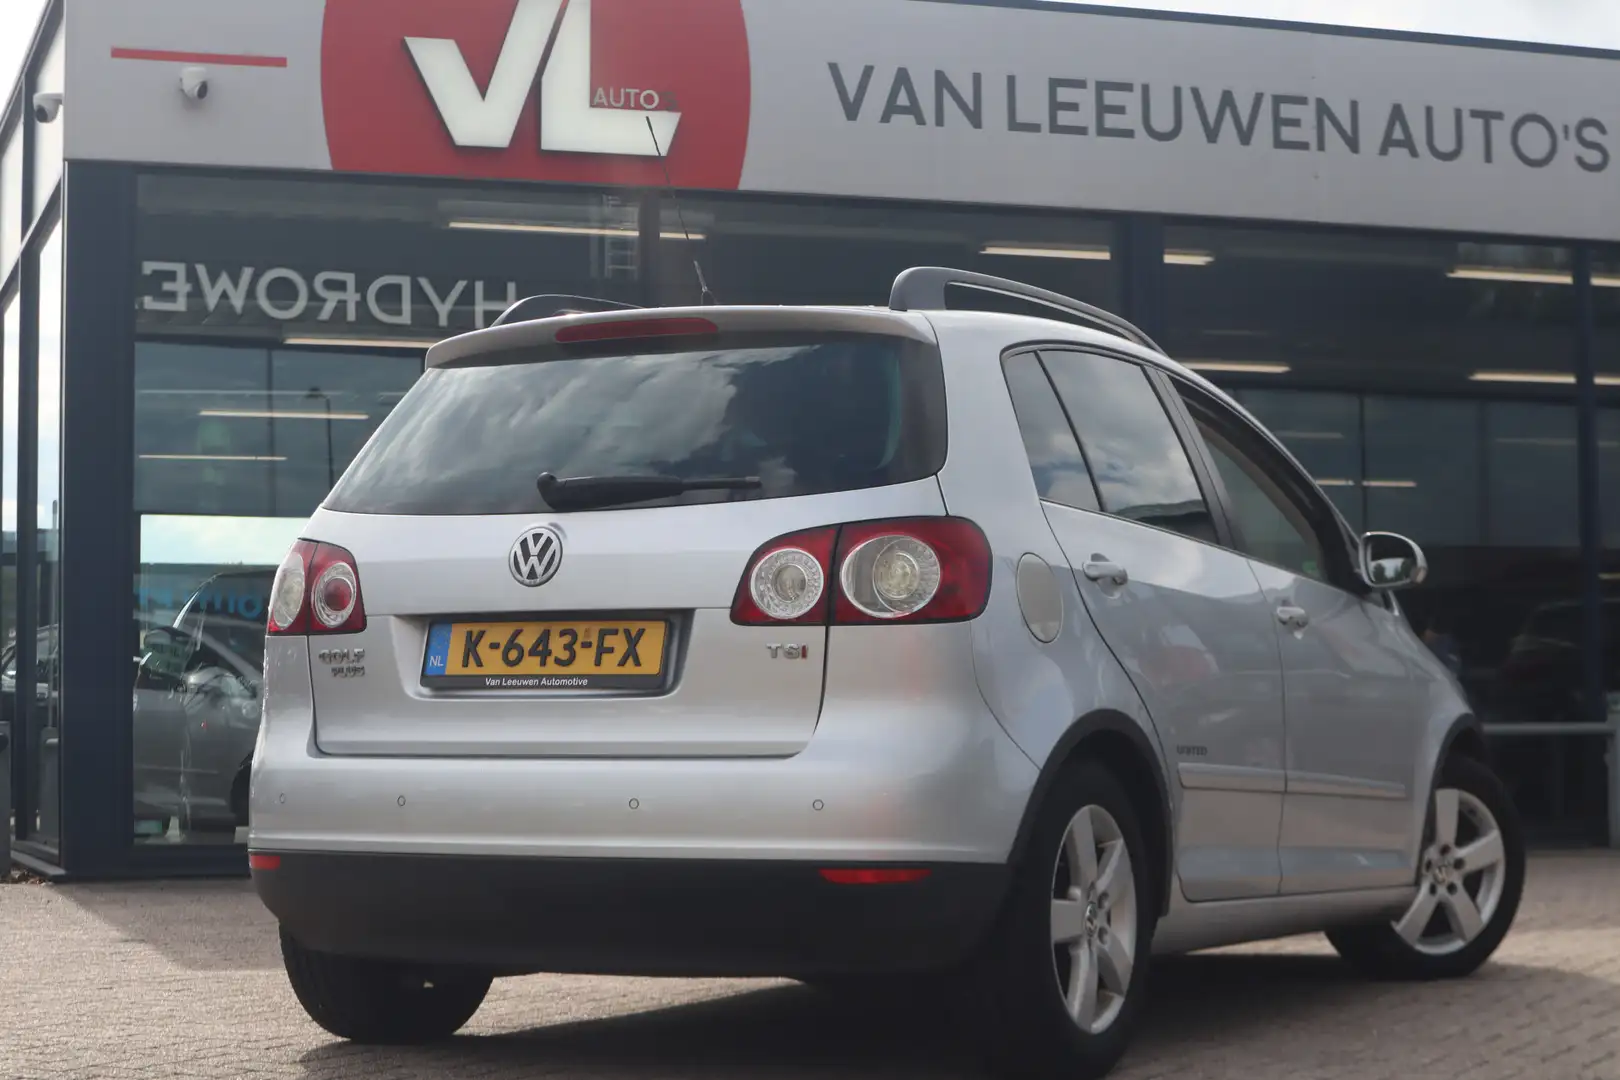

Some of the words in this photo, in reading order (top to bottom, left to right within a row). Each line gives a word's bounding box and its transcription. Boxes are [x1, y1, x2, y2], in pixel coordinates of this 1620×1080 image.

[404, 0, 681, 157] VL
[827, 62, 983, 129] VAN
[1006, 74, 1361, 155] LEEUWEN
[1378, 102, 1611, 173] AUTO'S
[429, 655, 444, 667] NL
[461, 628, 646, 668] K-643-FX
[485, 677, 501, 686] Van
[502, 677, 539, 686] Leeuwen
[540, 677, 588, 686] Automotive
